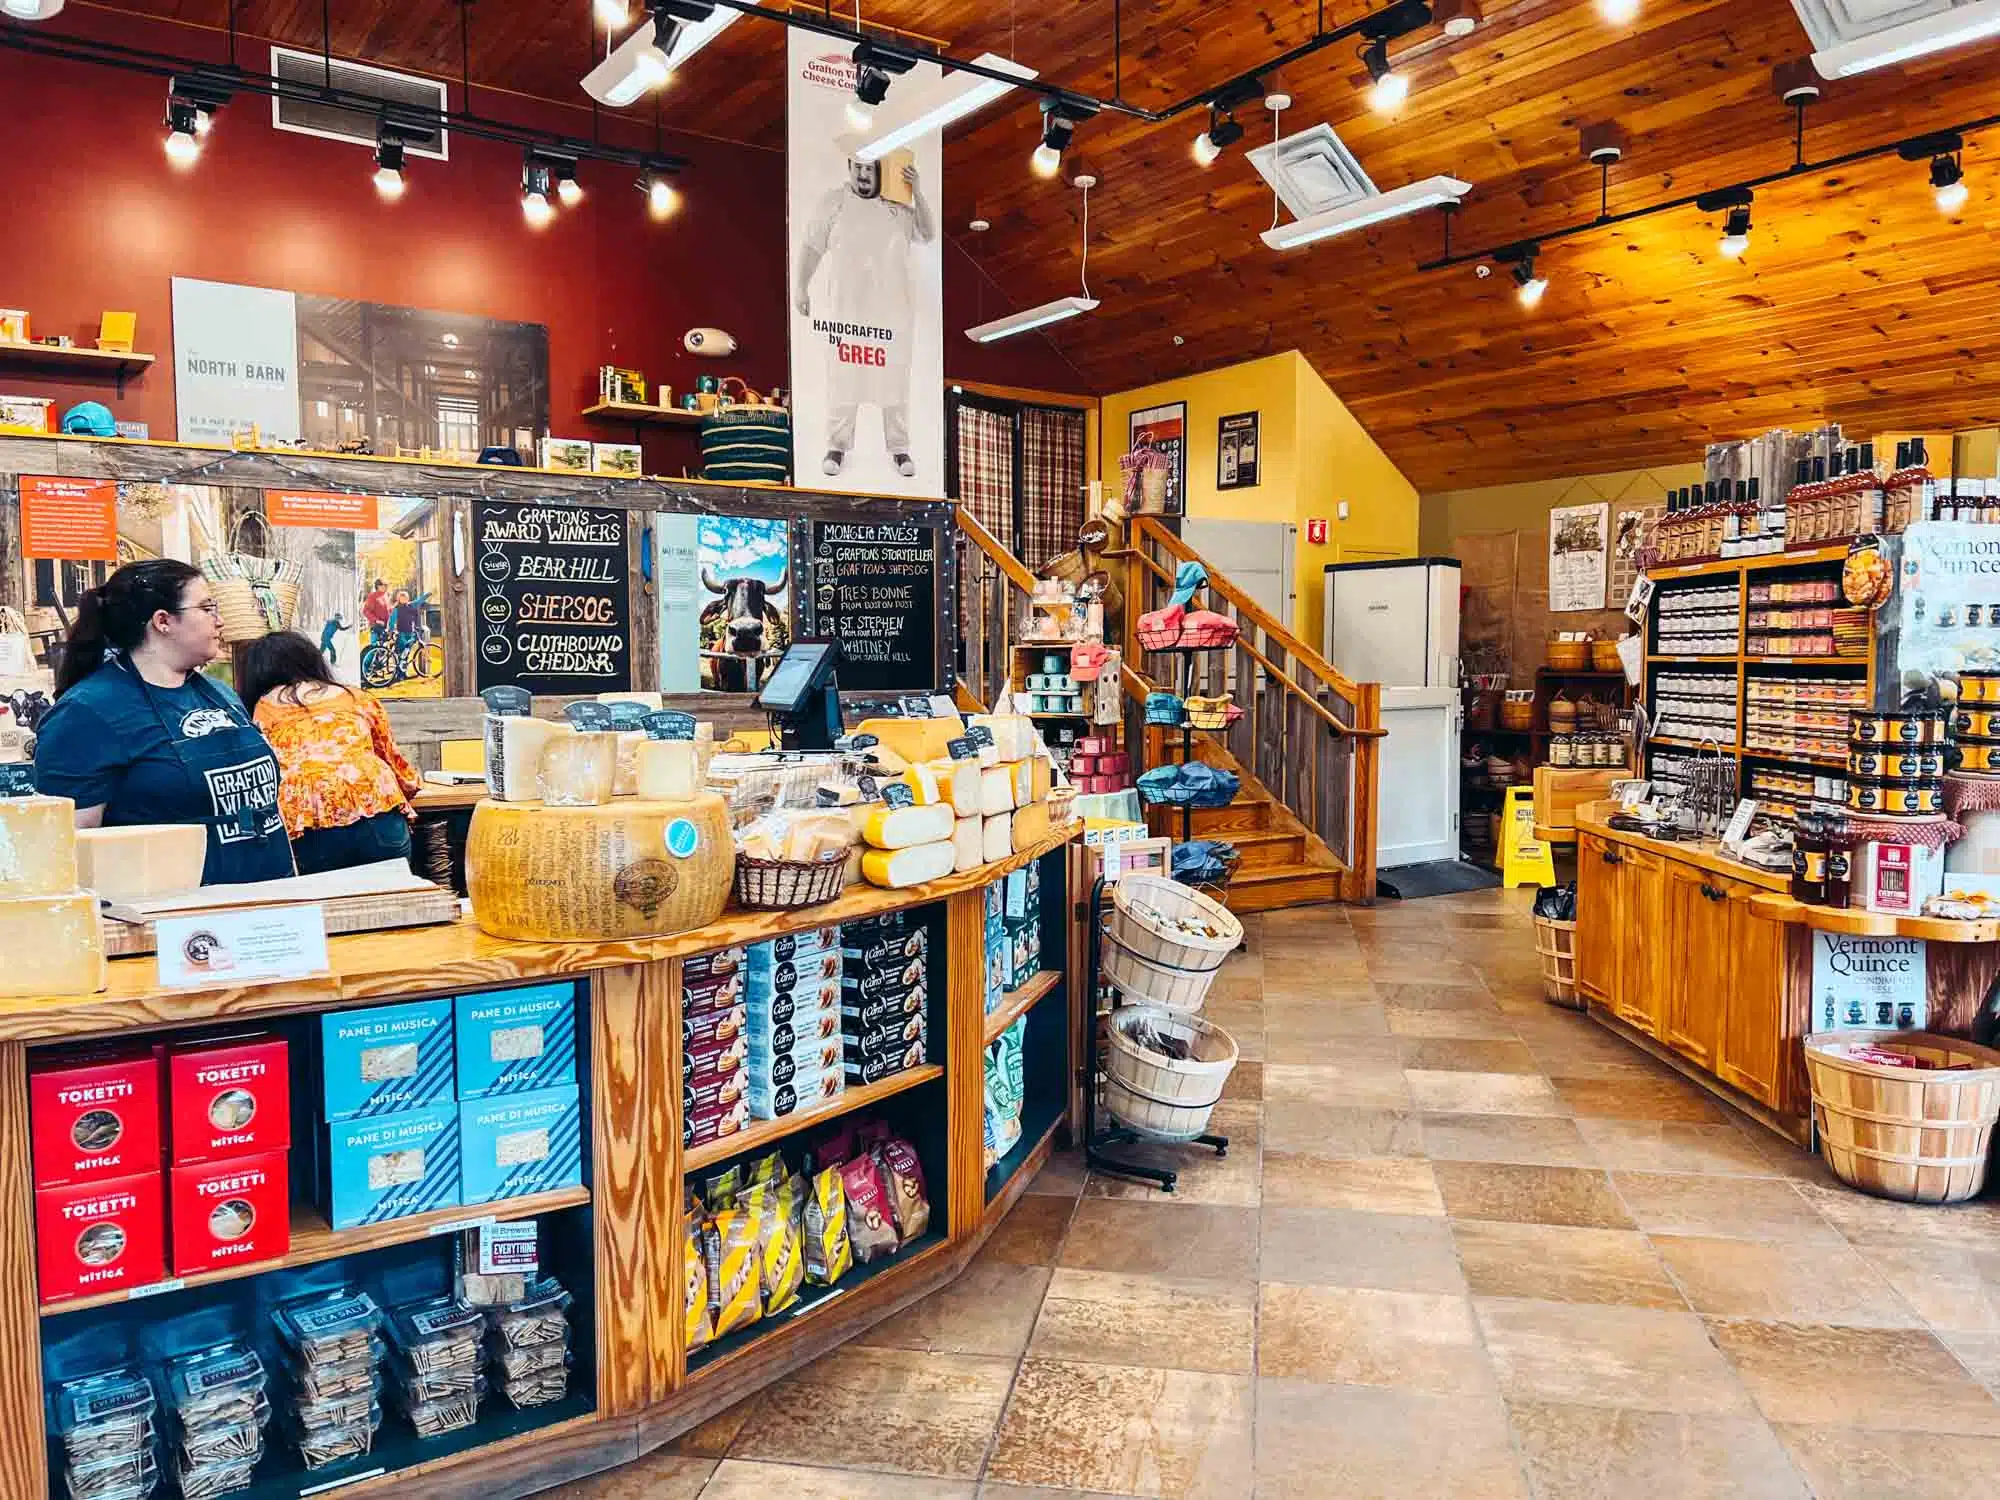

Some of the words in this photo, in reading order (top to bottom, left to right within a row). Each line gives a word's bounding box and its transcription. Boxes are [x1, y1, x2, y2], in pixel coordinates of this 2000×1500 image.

[802, 70, 836, 86] Cheese
[808, 61, 844, 77] Grafton
[813, 319, 893, 341] HANDCRAFTED
[829, 333, 842, 347] by
[838, 343, 886, 367] GREG
[188, 359, 236, 377] NORTH
[245, 363, 285, 382] BARN
[517, 508, 590, 526] GRAFTON'S
[483, 520, 542, 541] AWARD
[546, 522, 621, 542] WINNERS
[881, 547, 934, 561] STORYTELLER
[1915, 535, 2000, 557] Vermon
[518, 555, 568, 579] BEAR
[569, 557, 616, 580] HILL
[838, 584, 868, 602] TRES
[872, 585, 913, 600] BONNE
[486, 603, 507, 614] GOLD
[519, 592, 615, 622] SHEPSOG
[857, 615, 905, 630] STEPHEN
[516, 633, 623, 653] CLOTHBOUND
[841, 639, 892, 655] WHITNEY
[526, 653, 614, 673] CHEDDAR
[213, 761, 274, 796] GRAFTON
[1824, 934, 1920, 954] Vermont
[1830, 952, 1910, 976] Quince
[470, 1007, 501, 1020] PANE
[503, 1006, 517, 1016] DI
[519, 1000, 562, 1014] MUSICA
[338, 1026, 371, 1039] PANE
[375, 1024, 388, 1034] DI
[391, 1017, 438, 1031] MUSICA
[196, 1063, 266, 1085] TOKETTI
[58, 1083, 133, 1105] TOKETTI
[524, 1103, 567, 1118] MUSICA
[346, 1133, 379, 1147] PANE
[383, 1129, 396, 1141] DI
[398, 1121, 444, 1137] MUSICA
[196, 1173, 266, 1196] TOKETTI
[62, 1195, 136, 1219] TOKETTI
[494, 1242, 537, 1256] EVERYTHING
[341, 1305, 364, 1319] SALT
